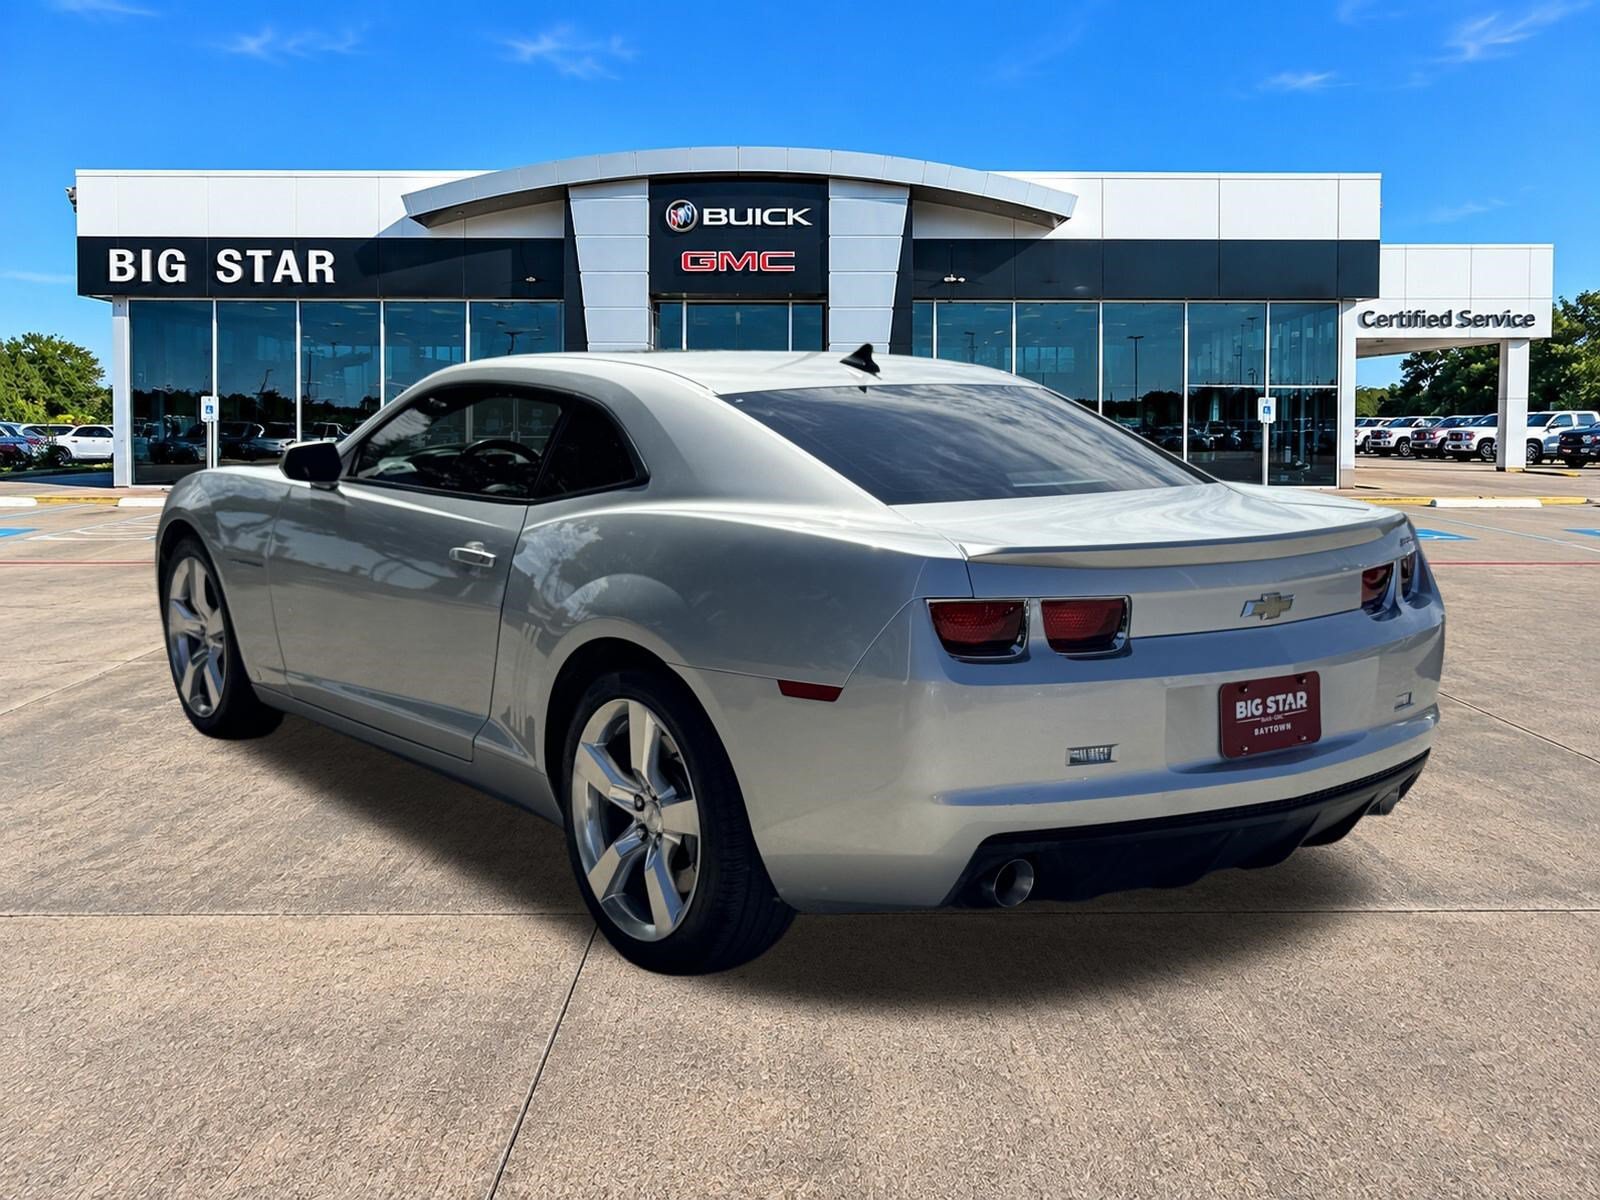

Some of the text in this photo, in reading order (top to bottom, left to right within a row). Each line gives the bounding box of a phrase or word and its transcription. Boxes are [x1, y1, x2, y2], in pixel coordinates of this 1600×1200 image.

[702, 207, 812, 226] BUICK
[108, 248, 335, 284] BIG STAR
[681, 250, 795, 272] GMC
[1361, 309, 1536, 328] Certified Service
[1235, 691, 1308, 720] BIG STAR
[1254, 722, 1292, 736] BAYTOWN
